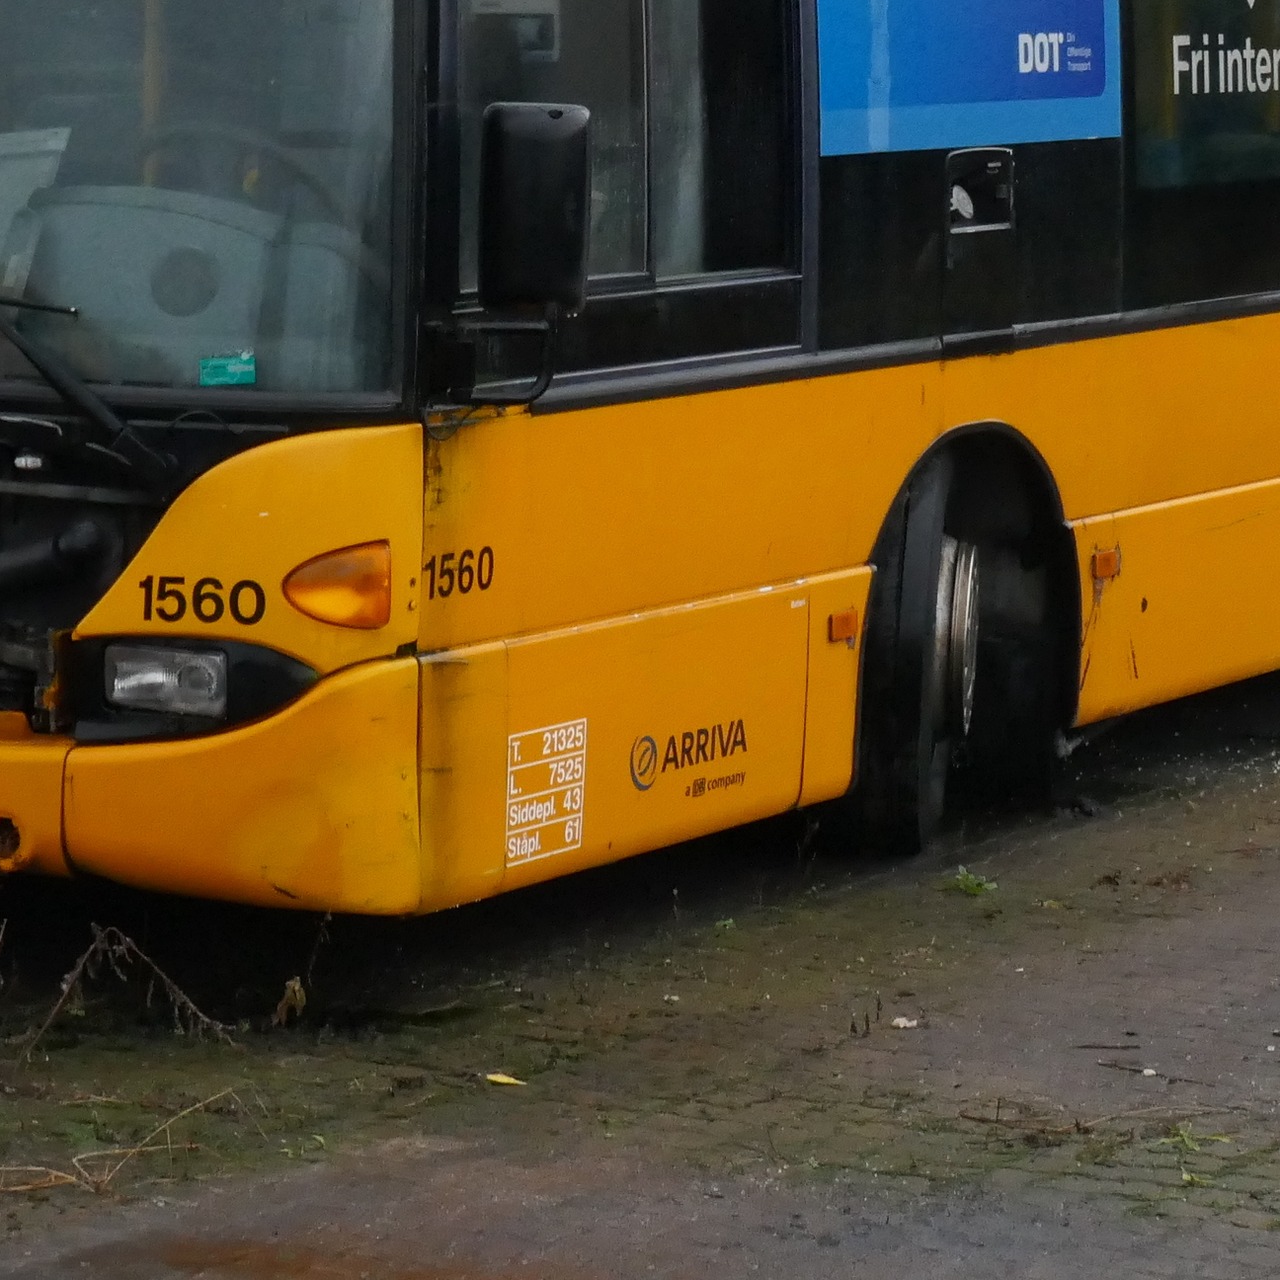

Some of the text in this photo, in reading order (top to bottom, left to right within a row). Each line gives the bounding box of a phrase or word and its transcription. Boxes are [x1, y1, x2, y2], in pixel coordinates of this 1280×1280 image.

[1018, 32, 1064, 73] DOT
[1172, 33, 1211, 94] Fri
[423, 546, 494, 600] 1560
[139, 574, 266, 626] 1560
[512, 724, 584, 762] T. 21325
[661, 718, 748, 773] ARRIVA
[510, 756, 582, 795] L. 7525
[685, 785, 691, 797] a
[707, 771, 746, 791] company
[509, 787, 581, 827] Siddepl. 43
[508, 820, 580, 859] Ståpl. 61
